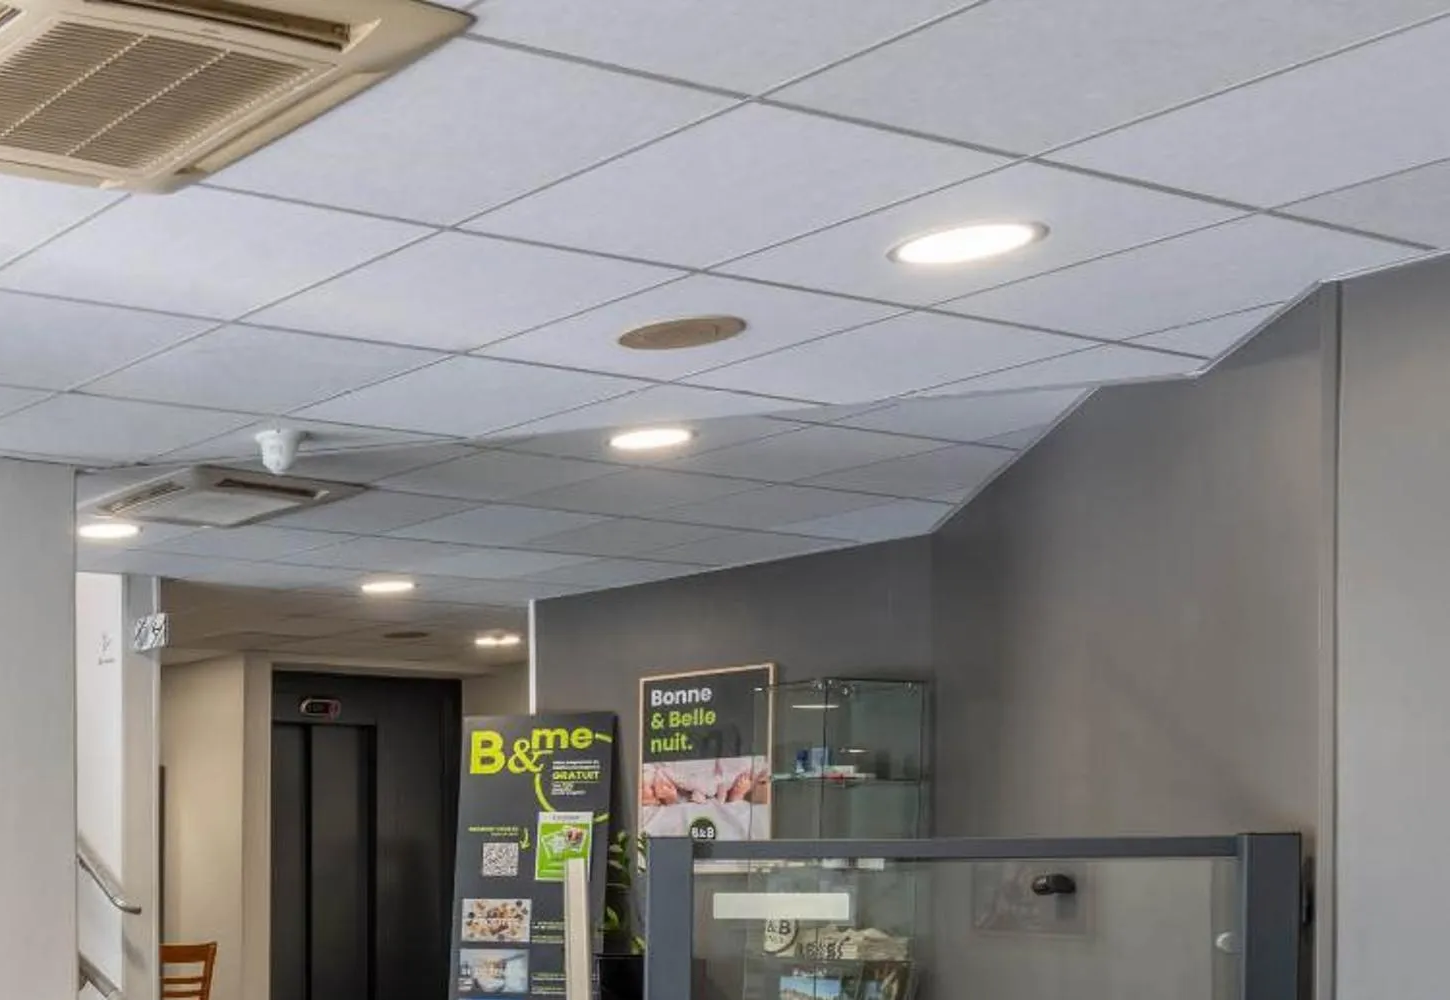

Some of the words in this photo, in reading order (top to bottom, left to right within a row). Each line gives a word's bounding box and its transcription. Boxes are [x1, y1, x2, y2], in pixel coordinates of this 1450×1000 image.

[651, 687, 713, 706] Bonne
[651, 711, 664, 730] &
[669, 707, 717, 728] Belle
[651, 732, 694, 753] nuit.
[552, 770, 600, 781] GRATUIT
[691, 826, 715, 838] B&B
